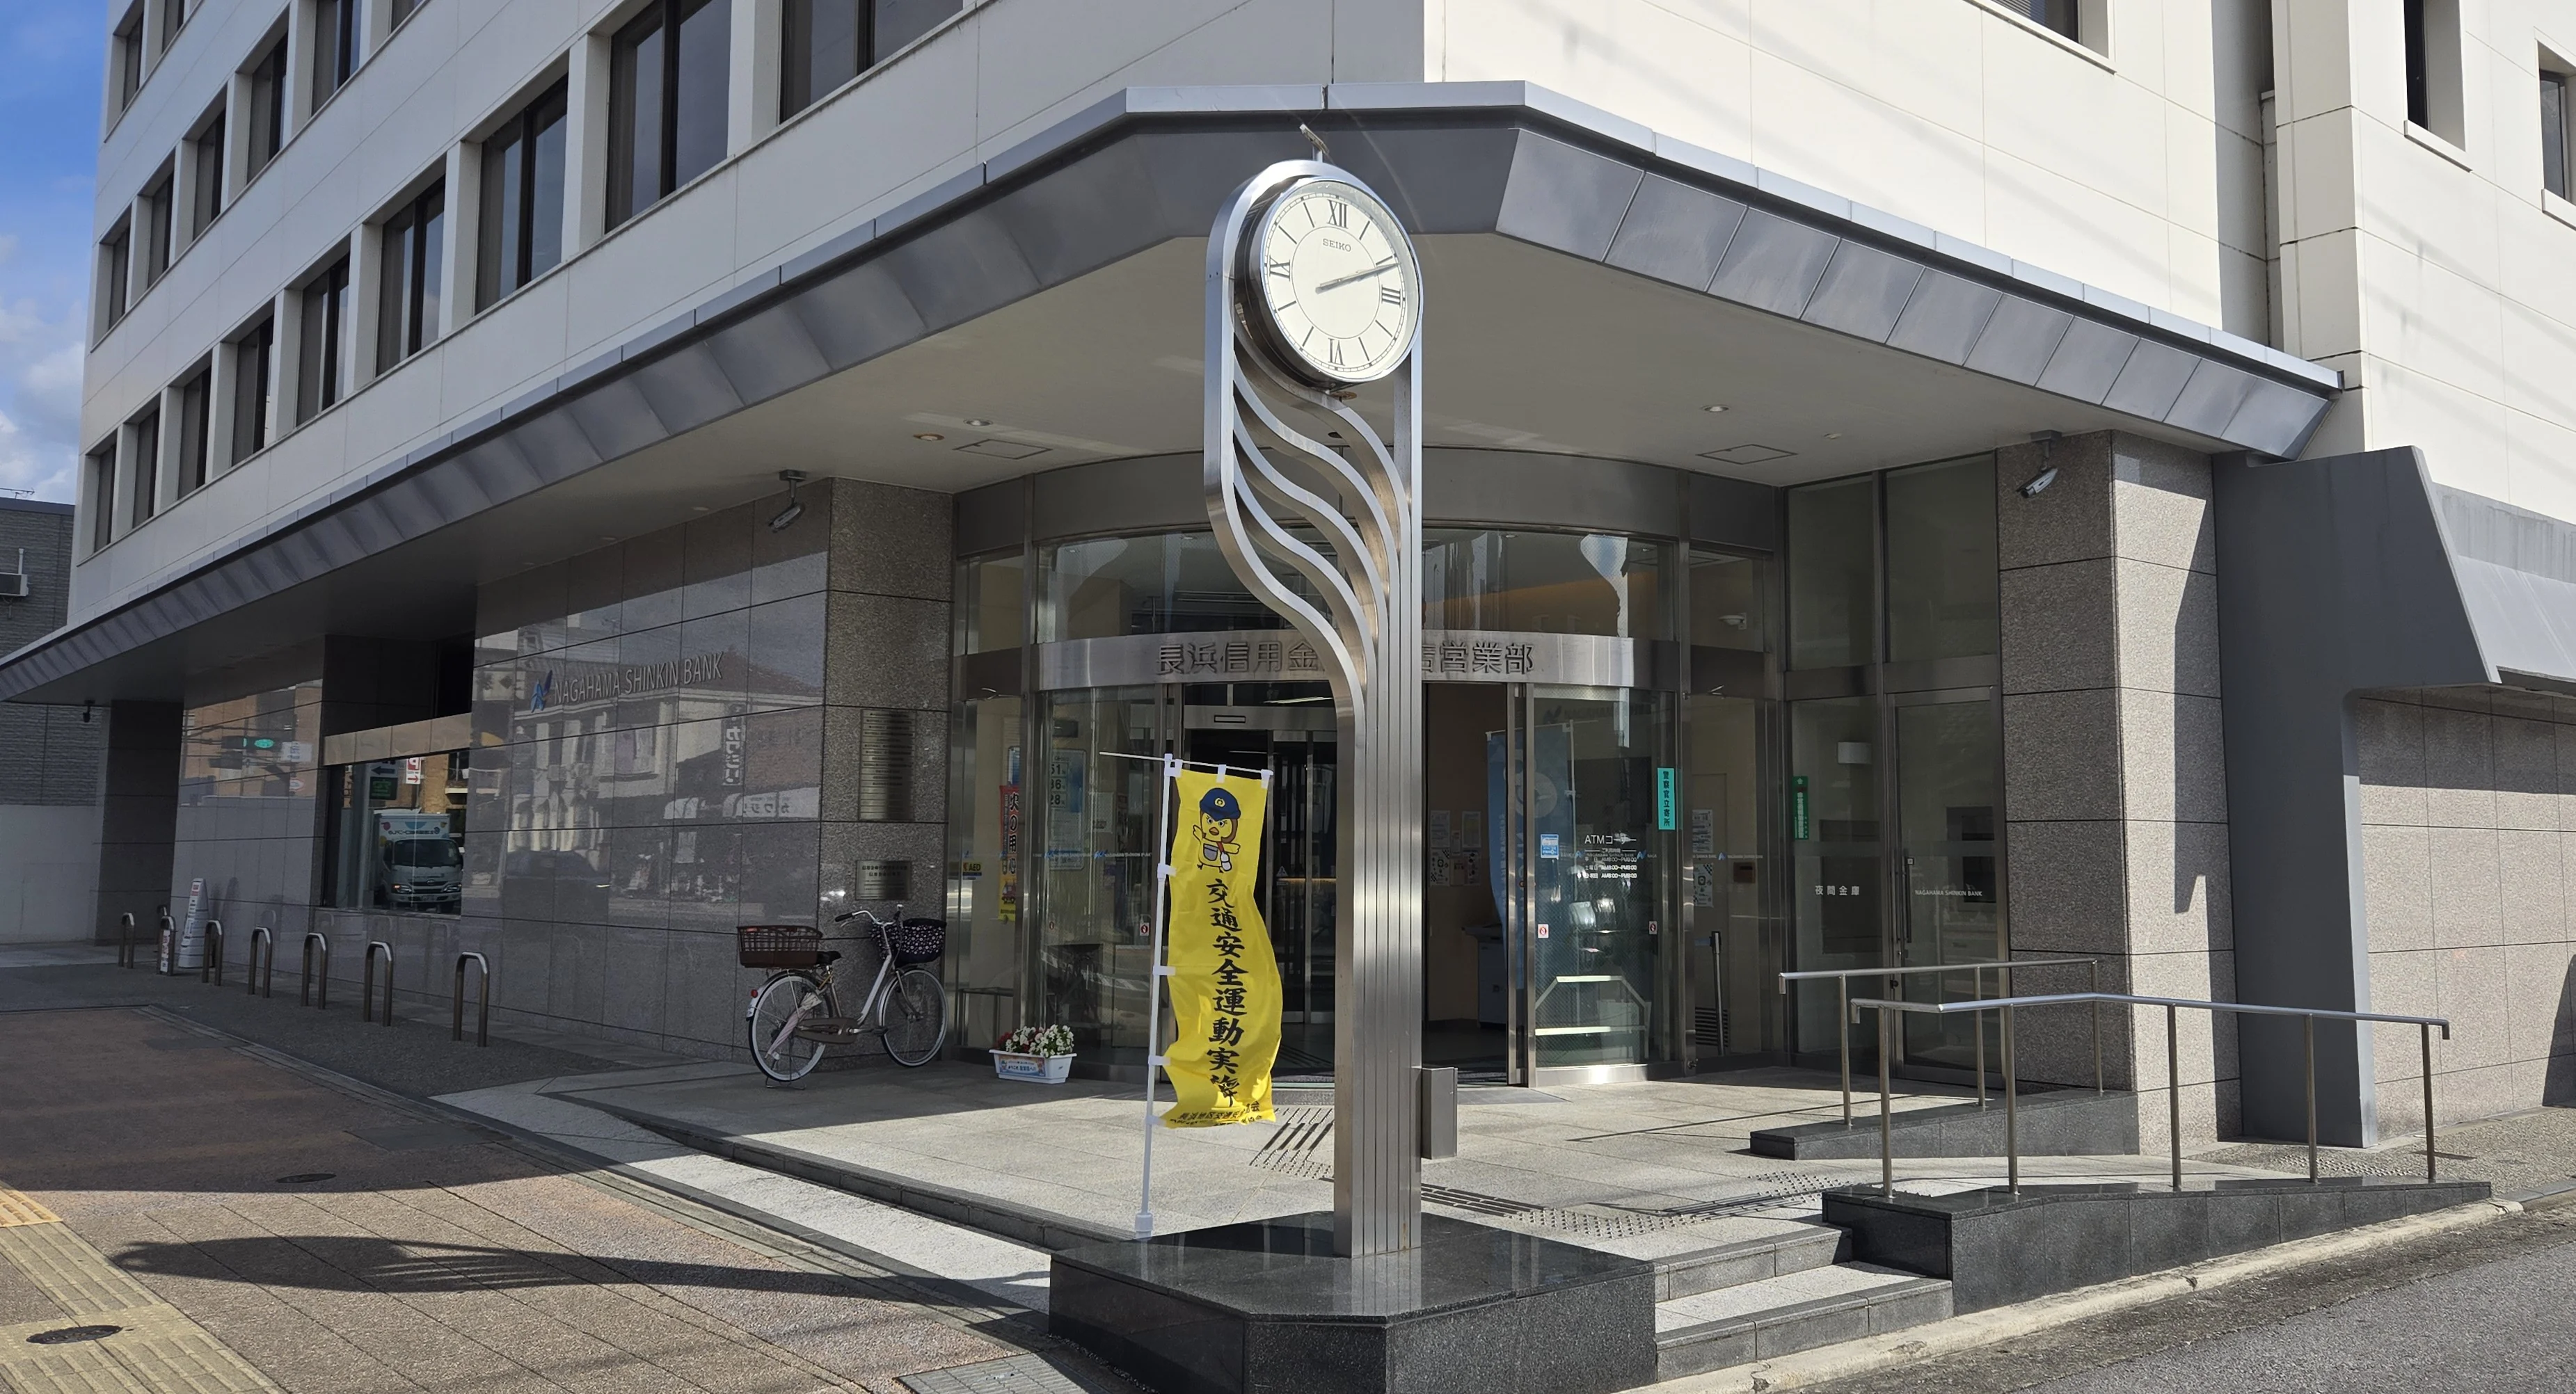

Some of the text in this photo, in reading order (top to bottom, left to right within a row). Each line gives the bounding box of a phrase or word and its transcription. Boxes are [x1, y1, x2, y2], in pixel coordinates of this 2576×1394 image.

[1326, 200, 1349, 229] XII
[1323, 238, 1351, 253] SEIKO
[1269, 255, 1291, 282] IX
[1381, 286, 1401, 307] III
[1328, 337, 1346, 366] VI
[1156, 641, 1324, 674] 長浜信用金
[554, 651, 724, 704] NAGAHAMA SHINKIN BANK
[1662, 771, 1671, 826] 警察官立寄所
[1815, 885, 1860, 896] 夜間金庫
